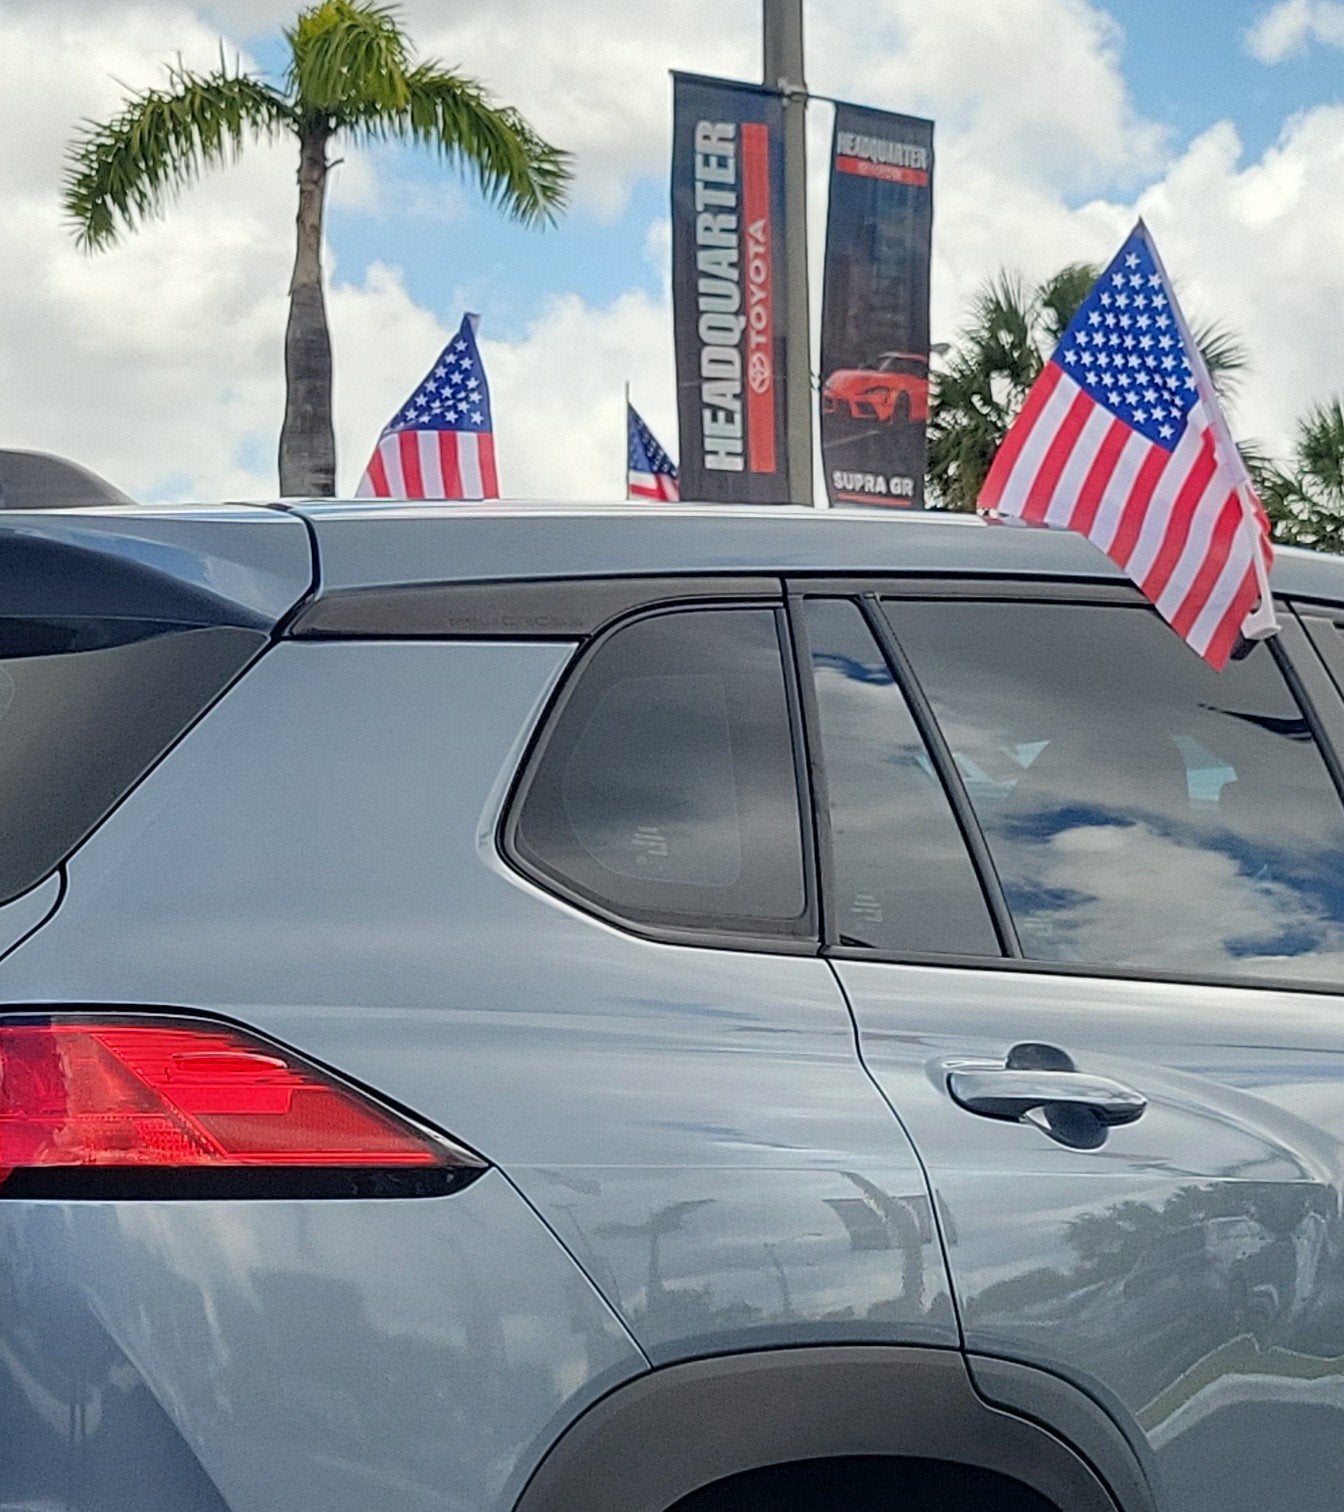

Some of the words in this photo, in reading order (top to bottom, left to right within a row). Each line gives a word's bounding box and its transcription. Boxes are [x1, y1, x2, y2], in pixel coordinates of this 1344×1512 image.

[695, 119, 747, 473] HEADQUARTER
[747, 219, 769, 346] TOYOTA
[833, 470, 888, 495] SUPRA
[889, 475, 915, 498] GR
